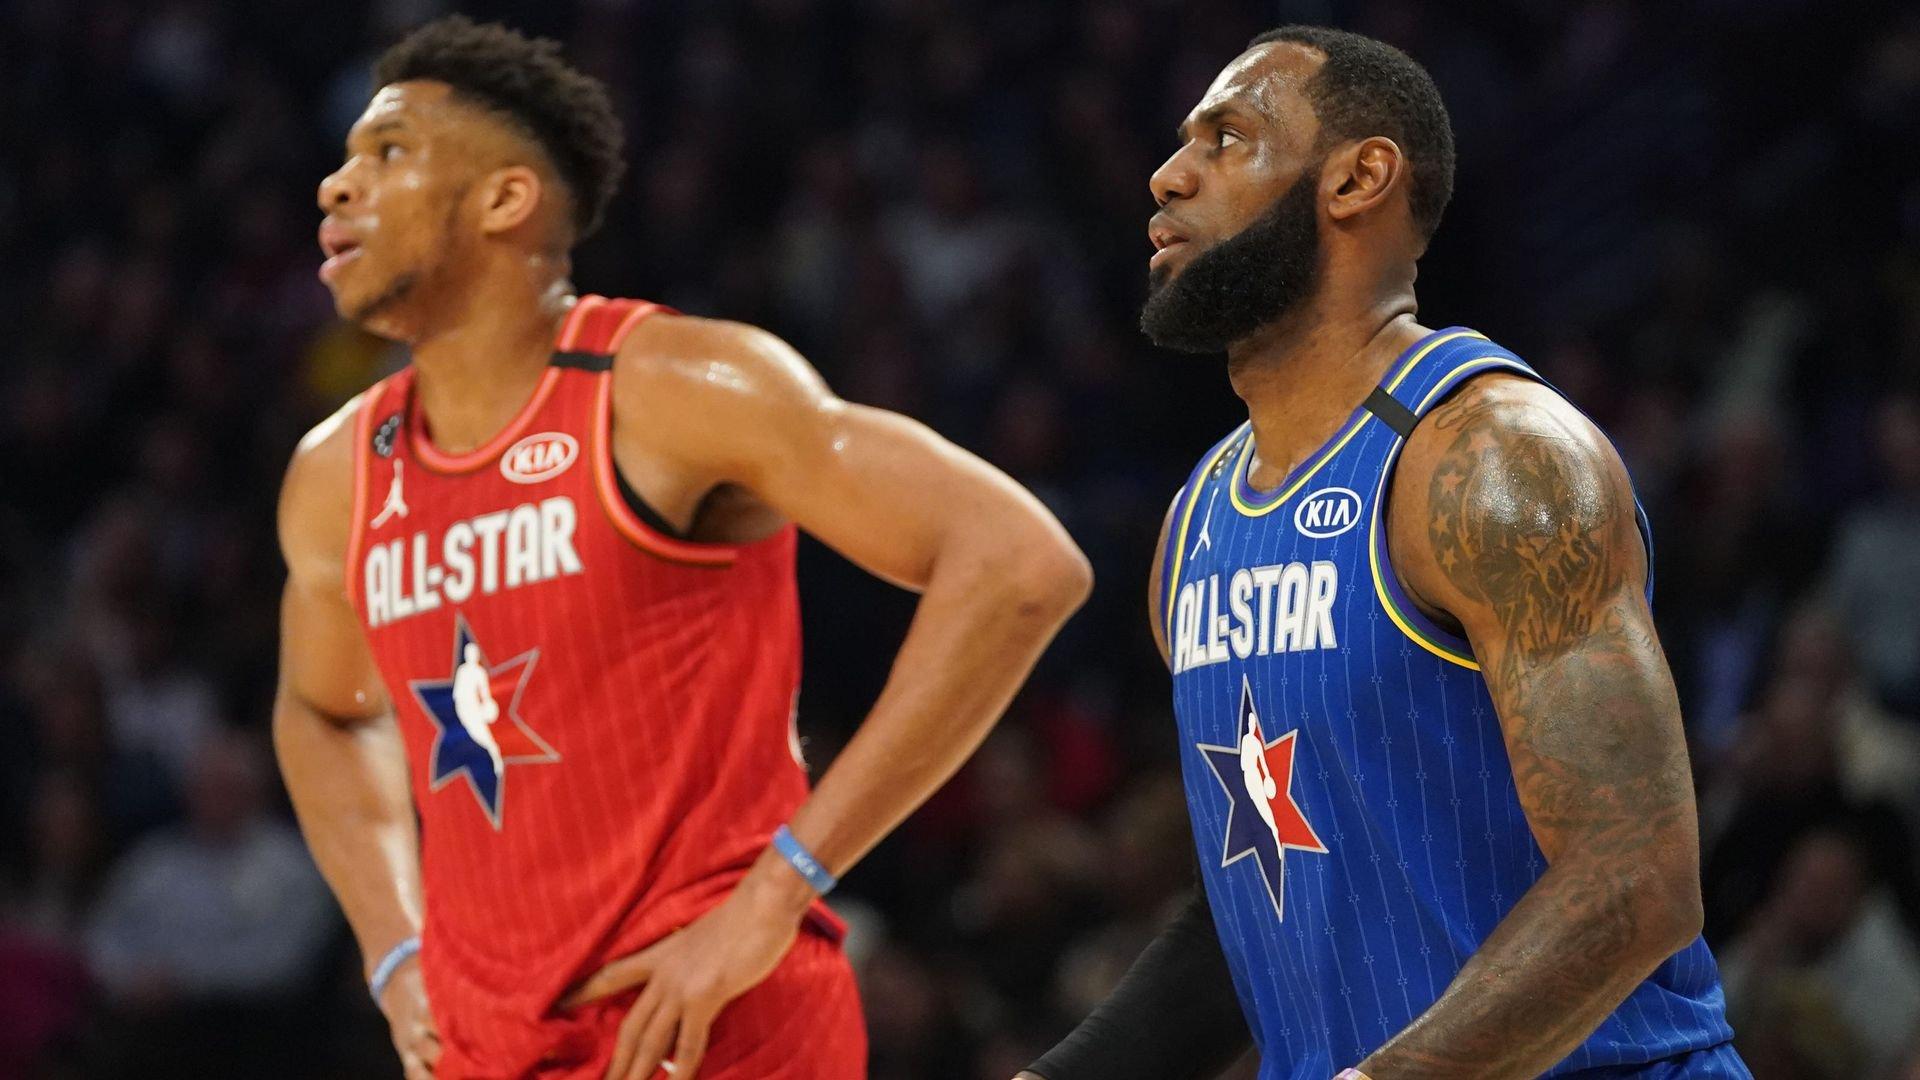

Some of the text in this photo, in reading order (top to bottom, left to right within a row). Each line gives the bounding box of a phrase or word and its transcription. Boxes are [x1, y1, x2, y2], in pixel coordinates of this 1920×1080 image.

[513, 441, 566, 474] KIA
[1305, 499, 1351, 528] KIA
[365, 496, 583, 628] ALL-STAR
[1173, 560, 1338, 675] ALL-STAR
